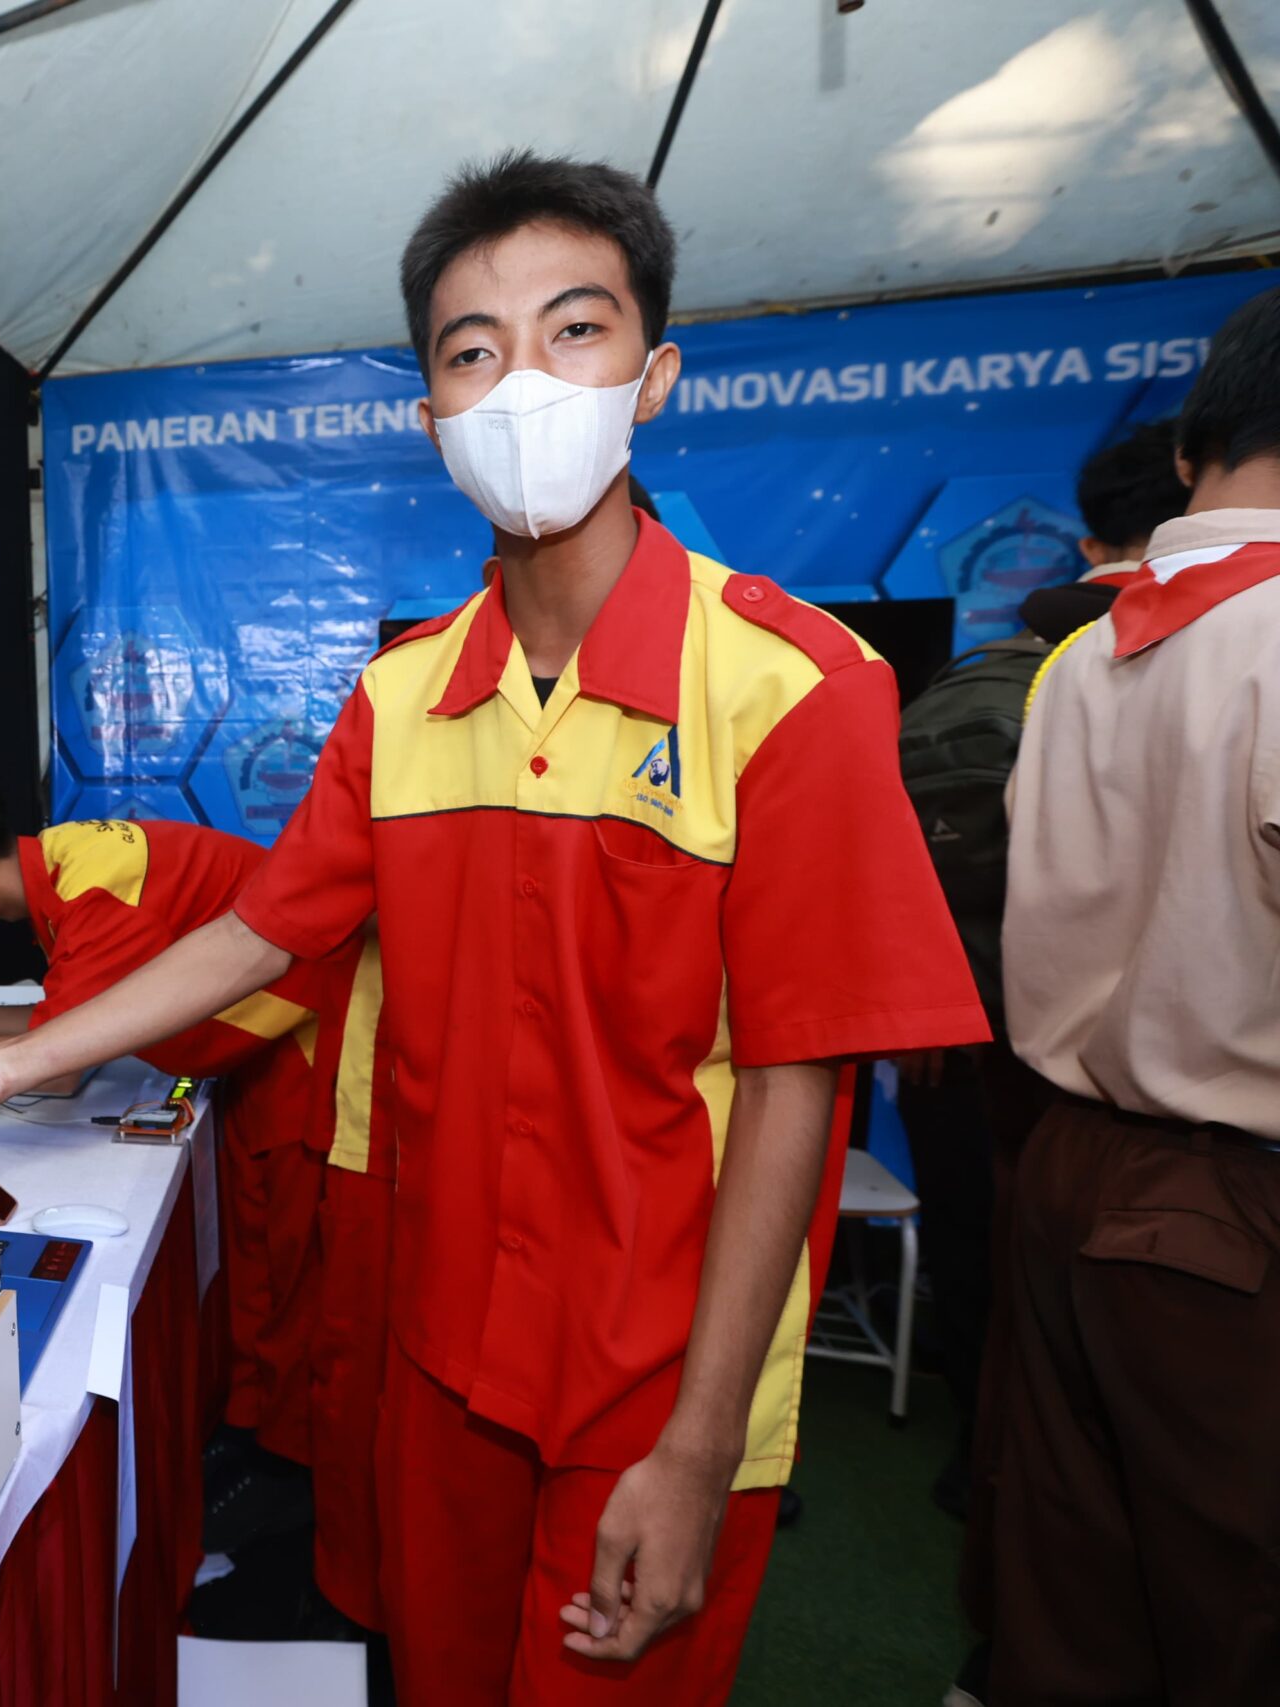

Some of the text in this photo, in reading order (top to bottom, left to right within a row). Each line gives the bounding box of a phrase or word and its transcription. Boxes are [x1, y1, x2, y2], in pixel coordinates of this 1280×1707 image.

[71, 409, 277, 454] PAMERAN
[678, 363, 886, 413] INOVASI
[902, 347, 1092, 396] KARYA
